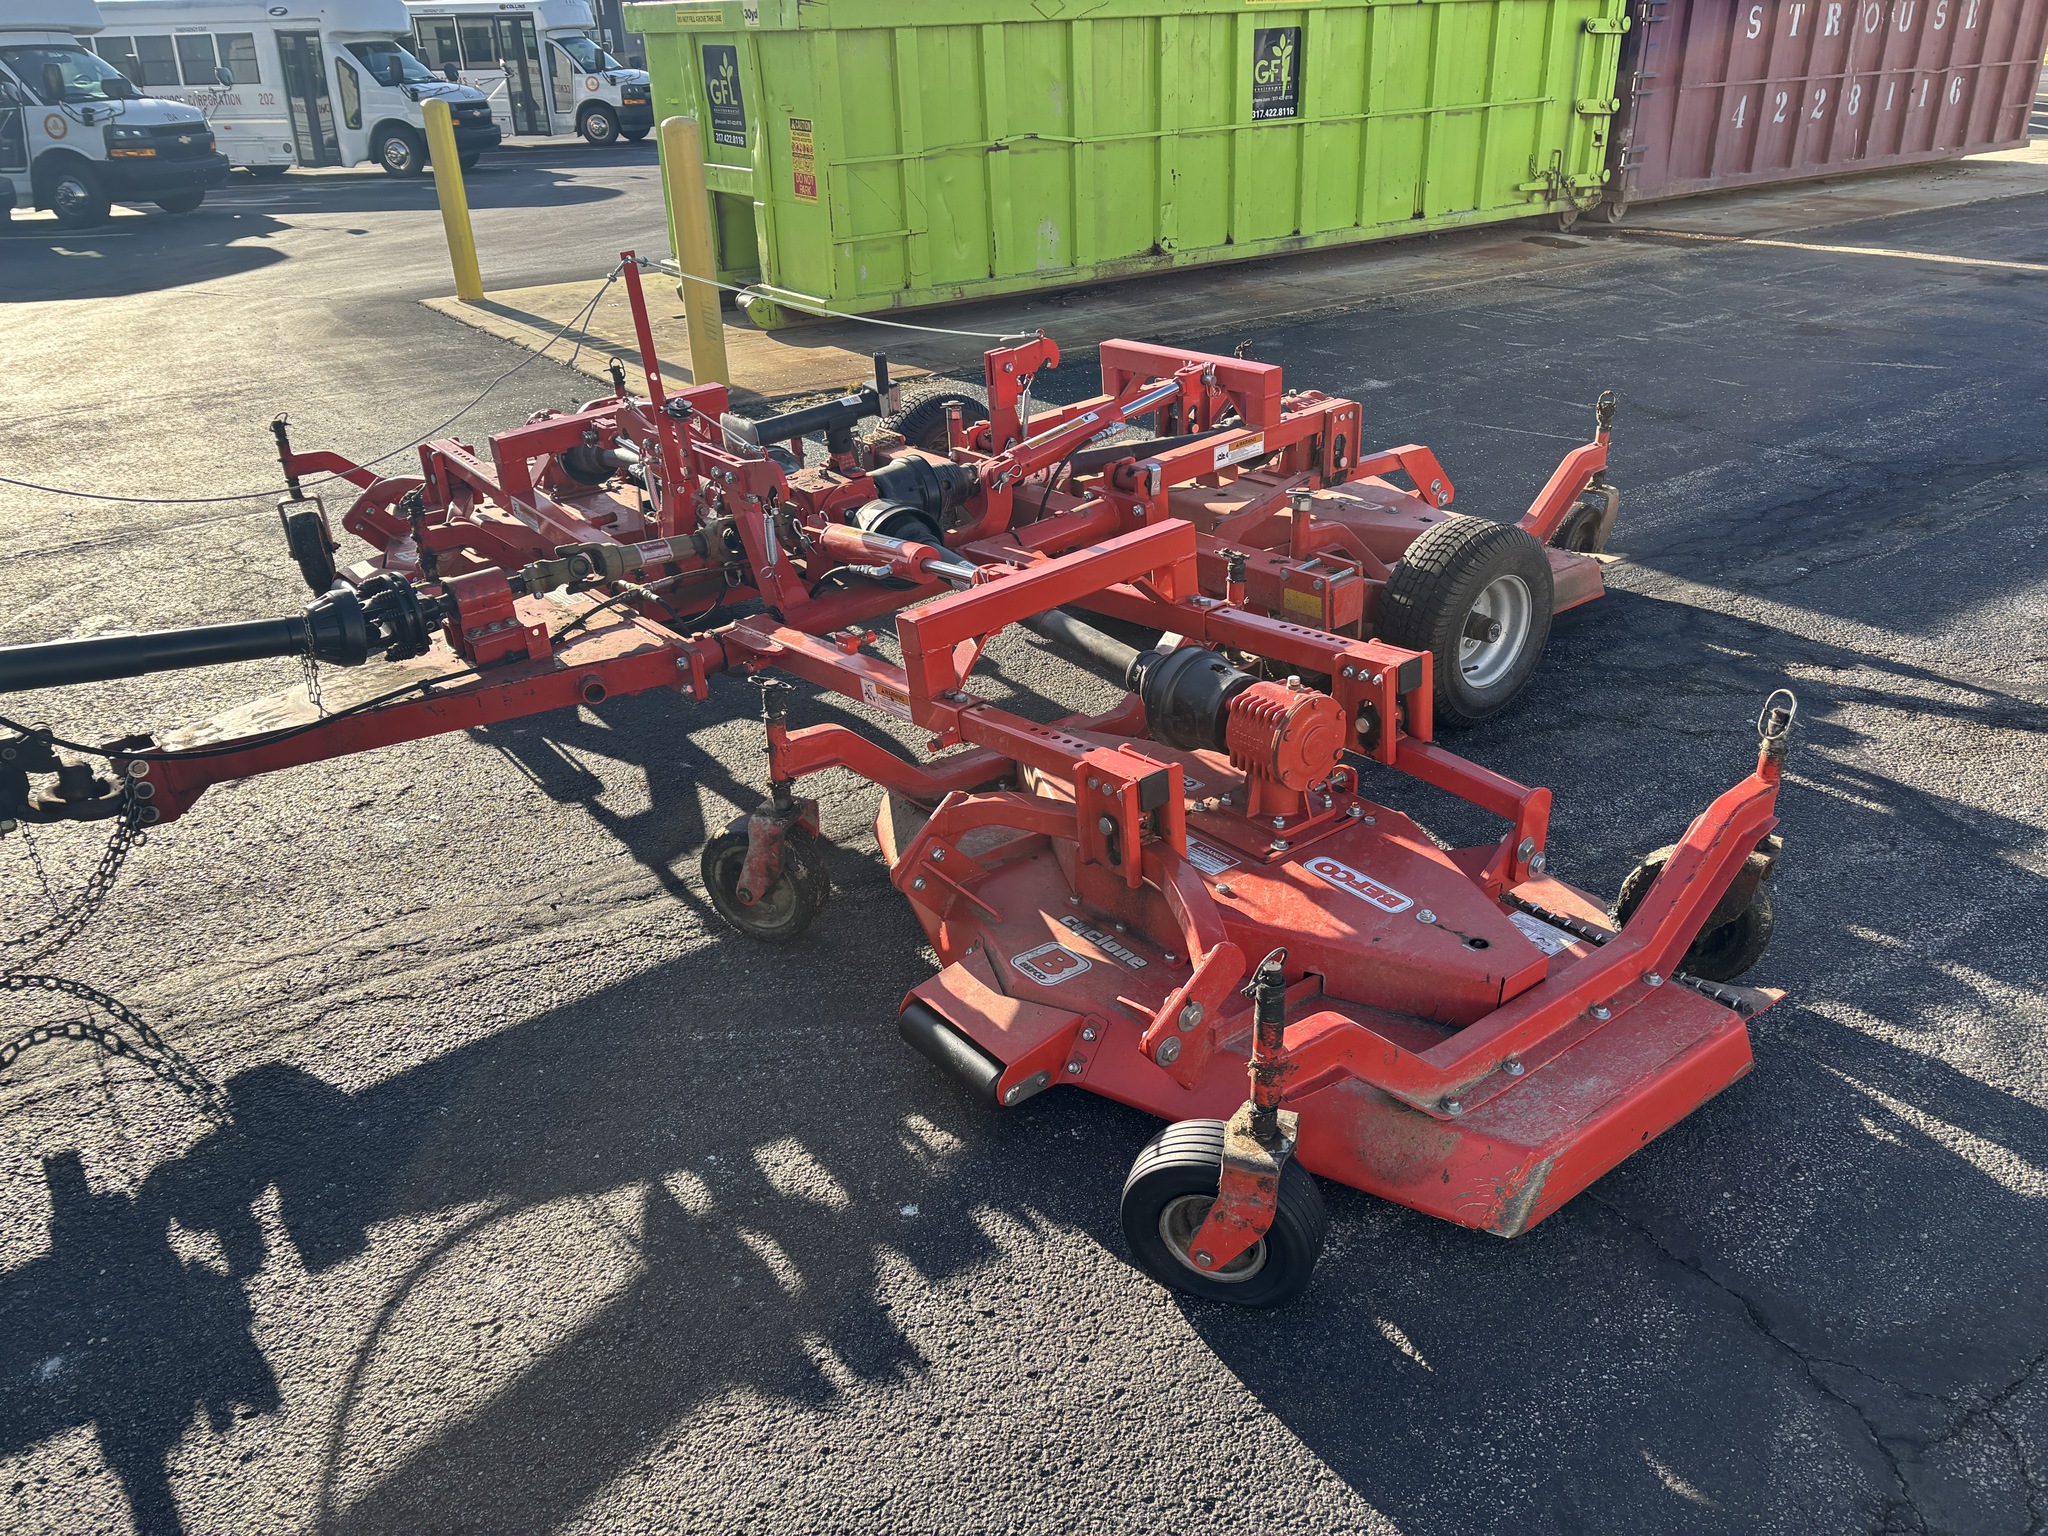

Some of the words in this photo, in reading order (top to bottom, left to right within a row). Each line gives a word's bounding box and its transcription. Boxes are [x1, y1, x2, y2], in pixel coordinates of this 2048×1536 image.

[744, 8, 758, 21] 30yd
[1746, 0, 1980, 39] STROUSE
[1255, 59, 1292, 84] GFL
[187, 94, 242, 107] CORPORATION
[258, 93, 275, 105] 202
[710, 79, 738, 105] GFL
[1731, 76, 1962, 129] 4228116
[1252, 107, 1295, 118] 317.422.8116
[796, 173, 804, 184] DO
[804, 174, 814, 186] NOT
[800, 184, 812, 196] PARK
[1314, 862, 1407, 909] BEFCO
[1059, 914, 1149, 970] cyclone
[1019, 961, 1047, 980] BEFCO
